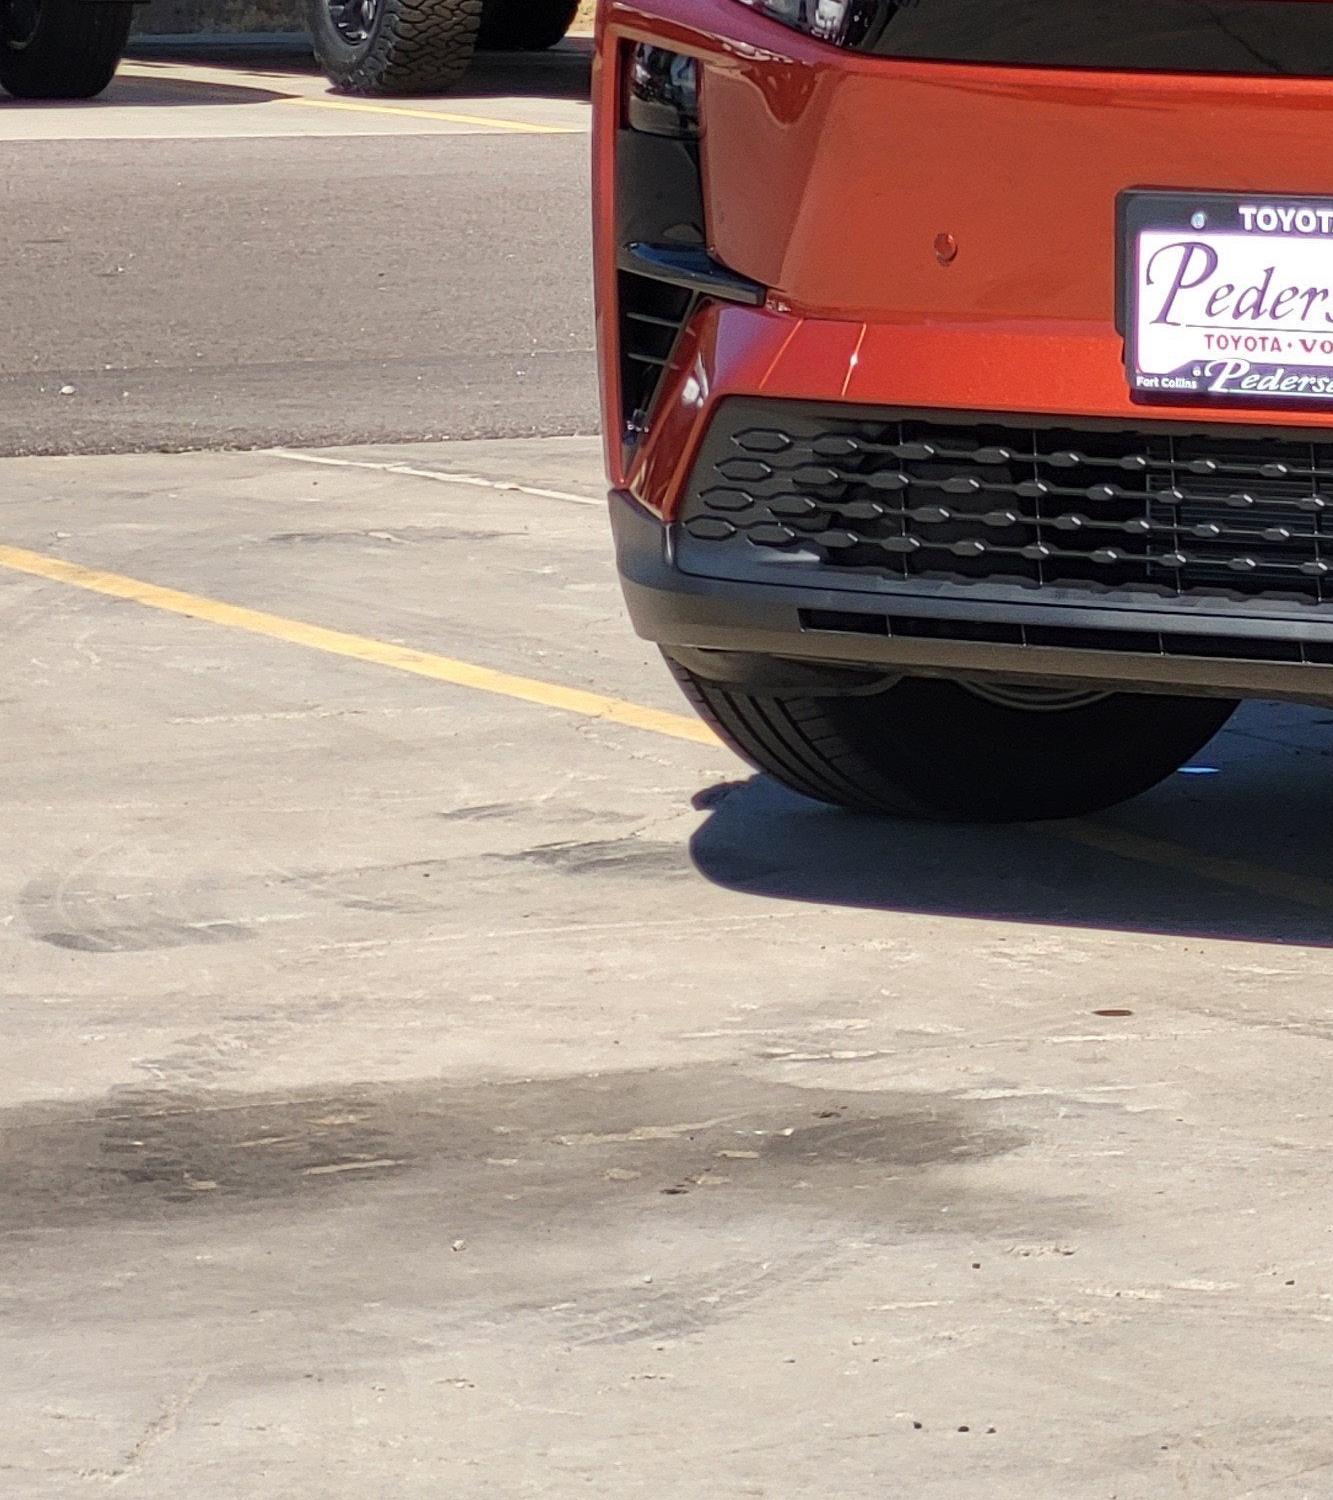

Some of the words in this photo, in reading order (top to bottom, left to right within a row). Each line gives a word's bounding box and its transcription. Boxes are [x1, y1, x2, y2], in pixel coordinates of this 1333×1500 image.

[1204, 333, 1281, 353] TOYOTA
[1136, 375, 1160, 388] Fort
[1161, 376, 1198, 389] Collins
